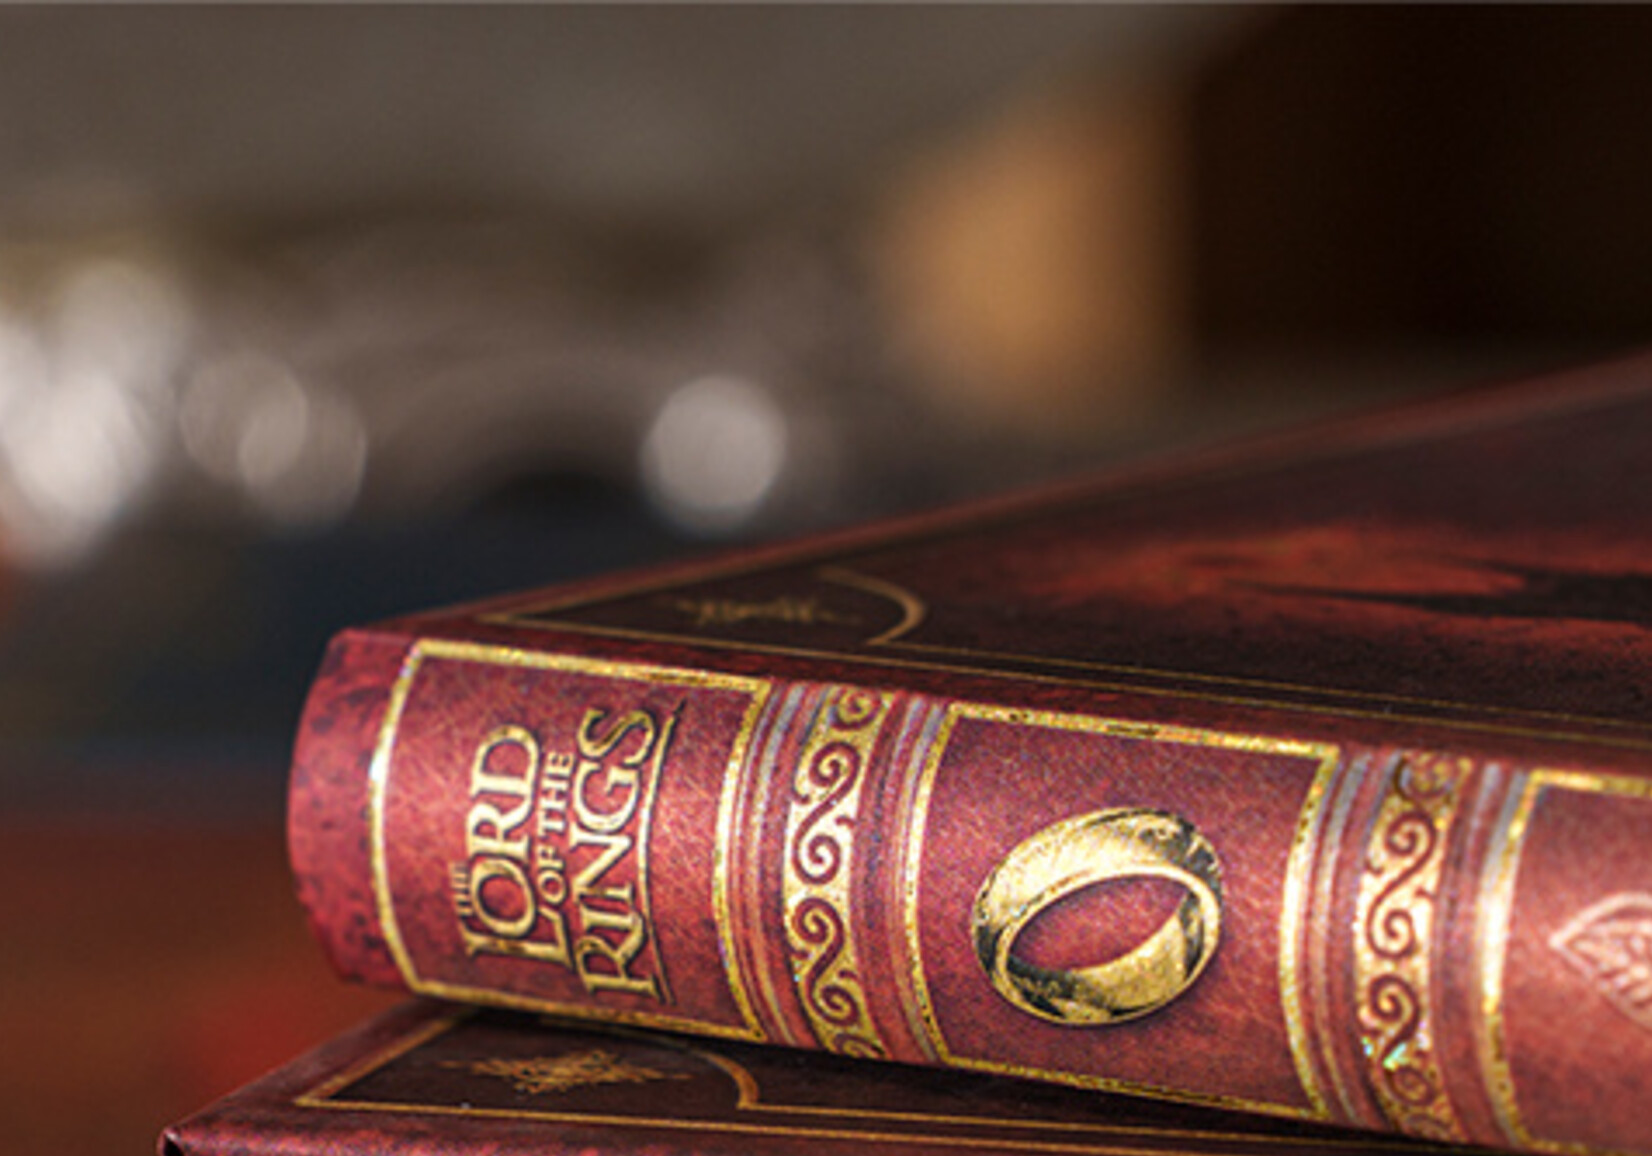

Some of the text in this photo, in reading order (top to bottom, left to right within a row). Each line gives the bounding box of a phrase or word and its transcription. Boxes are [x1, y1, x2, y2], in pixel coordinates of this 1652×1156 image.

[465, 723, 576, 972] LORD
[536, 751, 575, 904] OF THE
[569, 708, 663, 1000] RINGS
